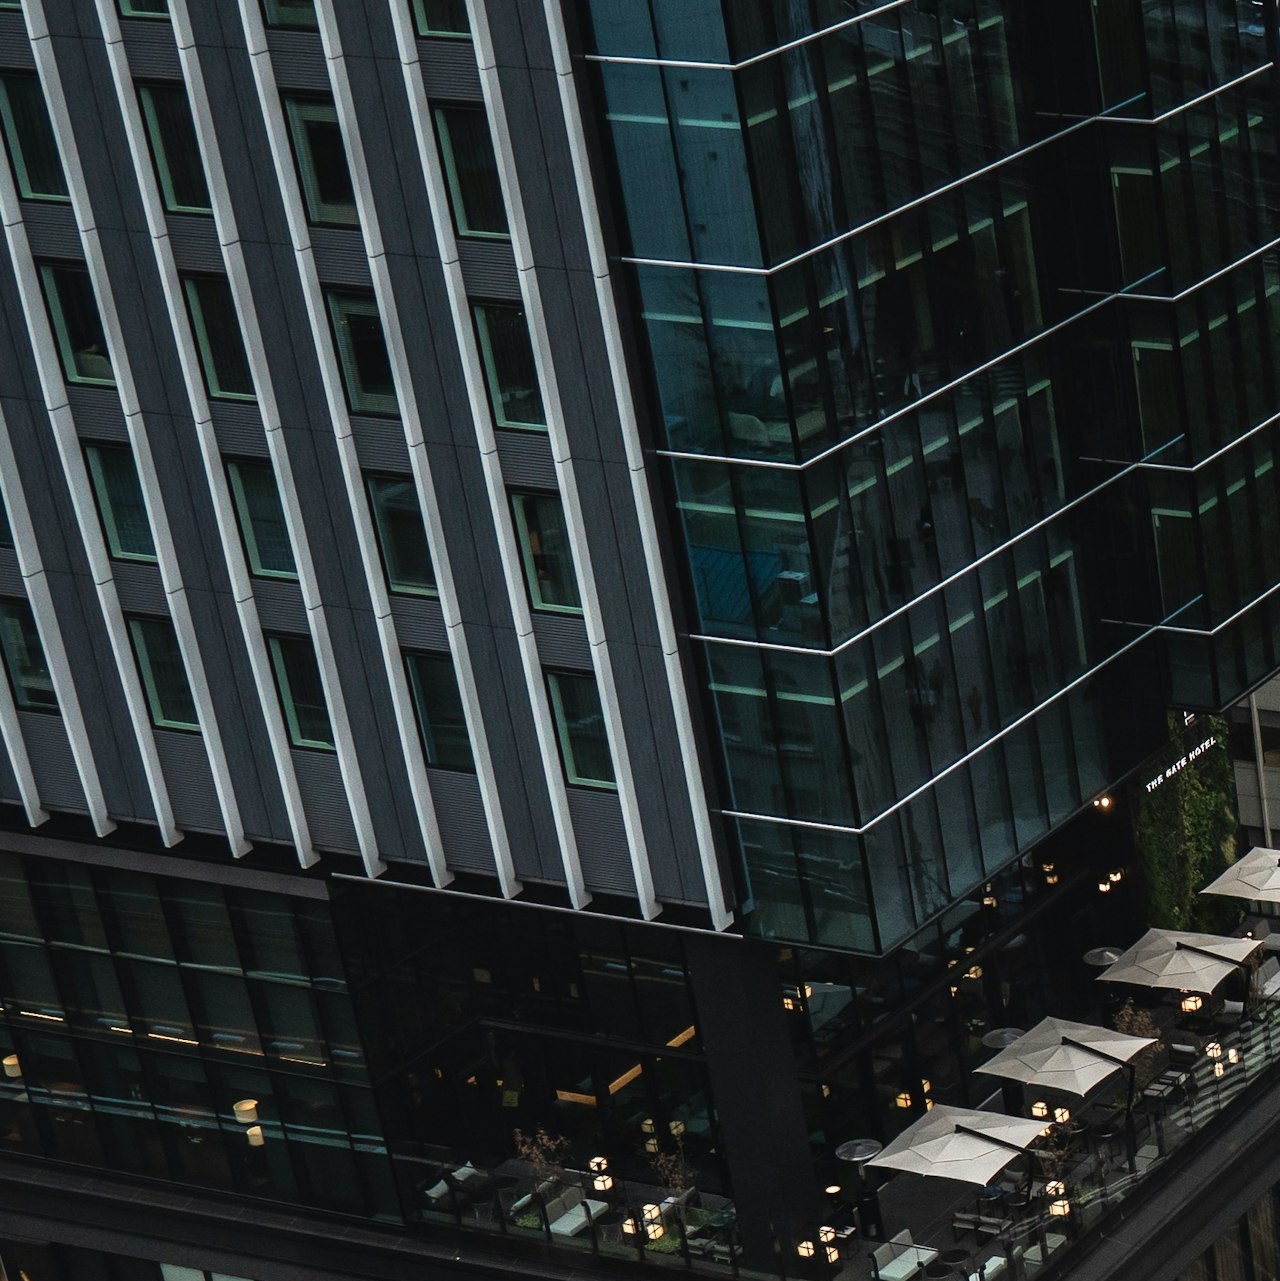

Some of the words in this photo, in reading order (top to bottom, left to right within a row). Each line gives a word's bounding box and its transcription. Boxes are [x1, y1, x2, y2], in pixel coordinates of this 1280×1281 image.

[1146, 774, 1164, 793] THE
[1165, 756, 1188, 778] GATE
[1188, 736, 1217, 762] HOTEL
